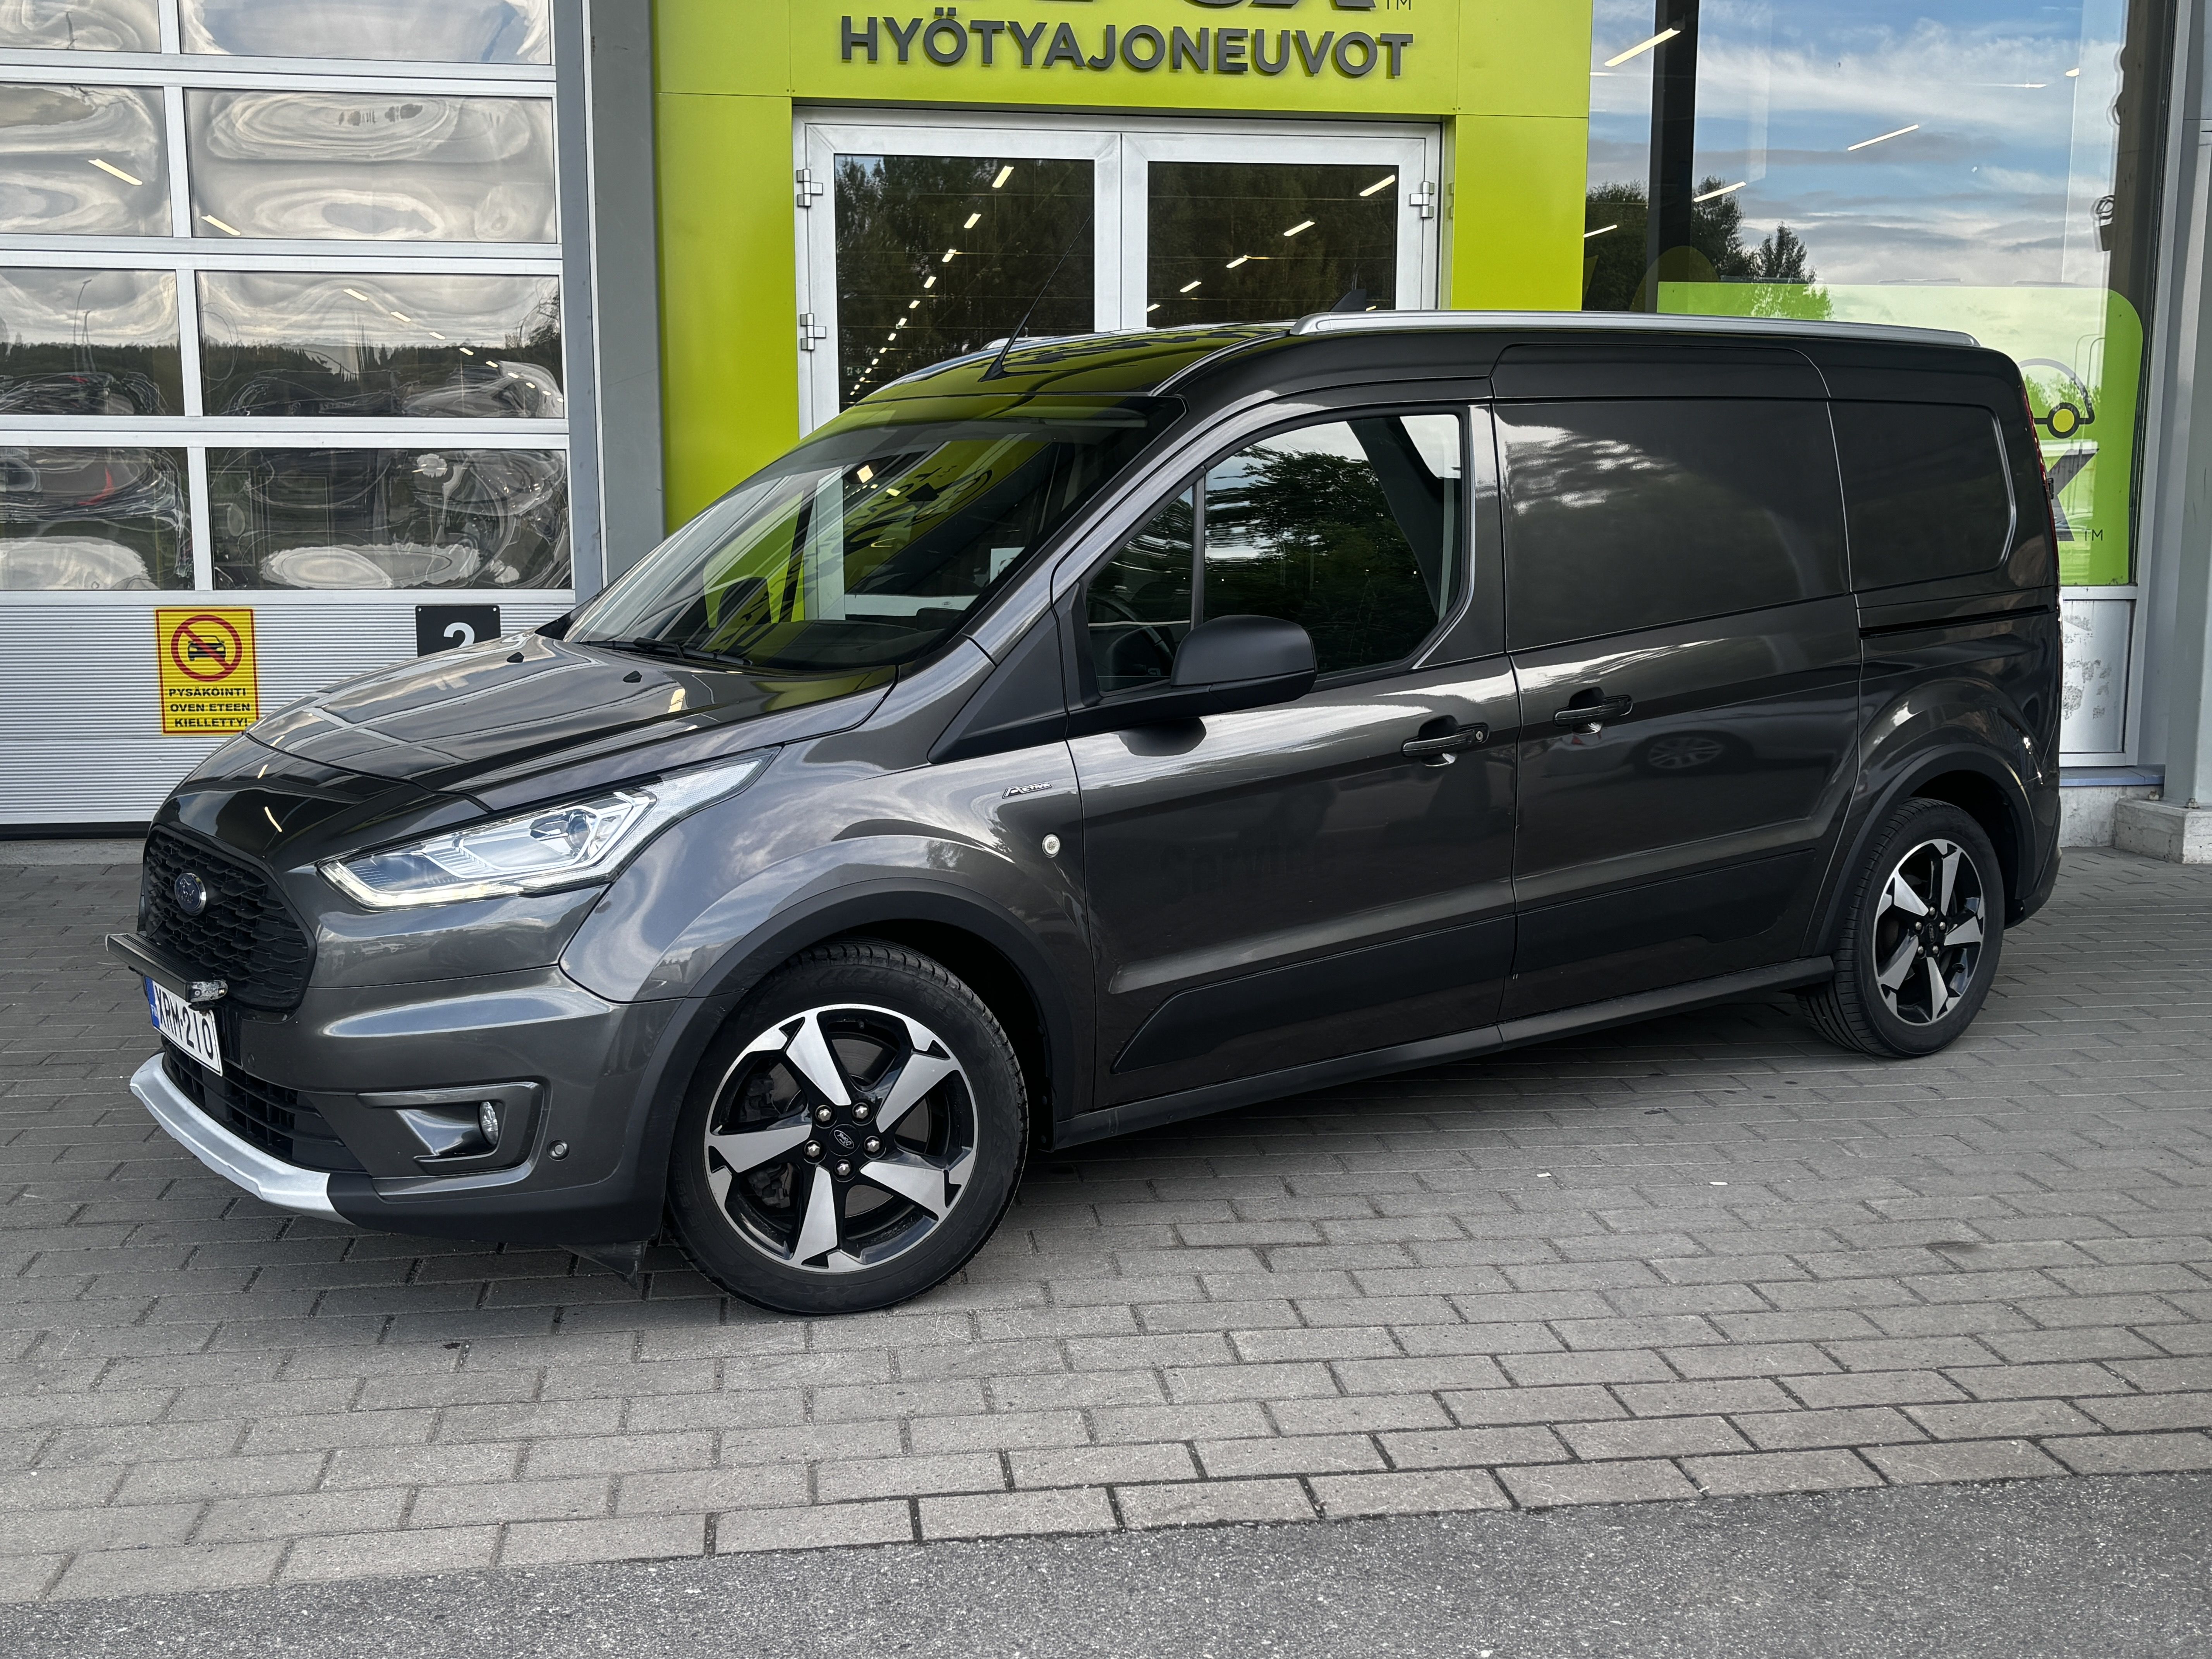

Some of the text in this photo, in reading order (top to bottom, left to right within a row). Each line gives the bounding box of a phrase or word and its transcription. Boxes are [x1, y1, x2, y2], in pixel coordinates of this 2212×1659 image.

[840, 7, 1413, 77] HYÖTYAJONEUVOT
[169, 687, 246, 697] PYSÄKÖINTI
[170, 703, 251, 712] OVEN ETEEN
[175, 718, 248, 727] KIELLETTY!
[155, 985, 214, 1060] XRM-210
